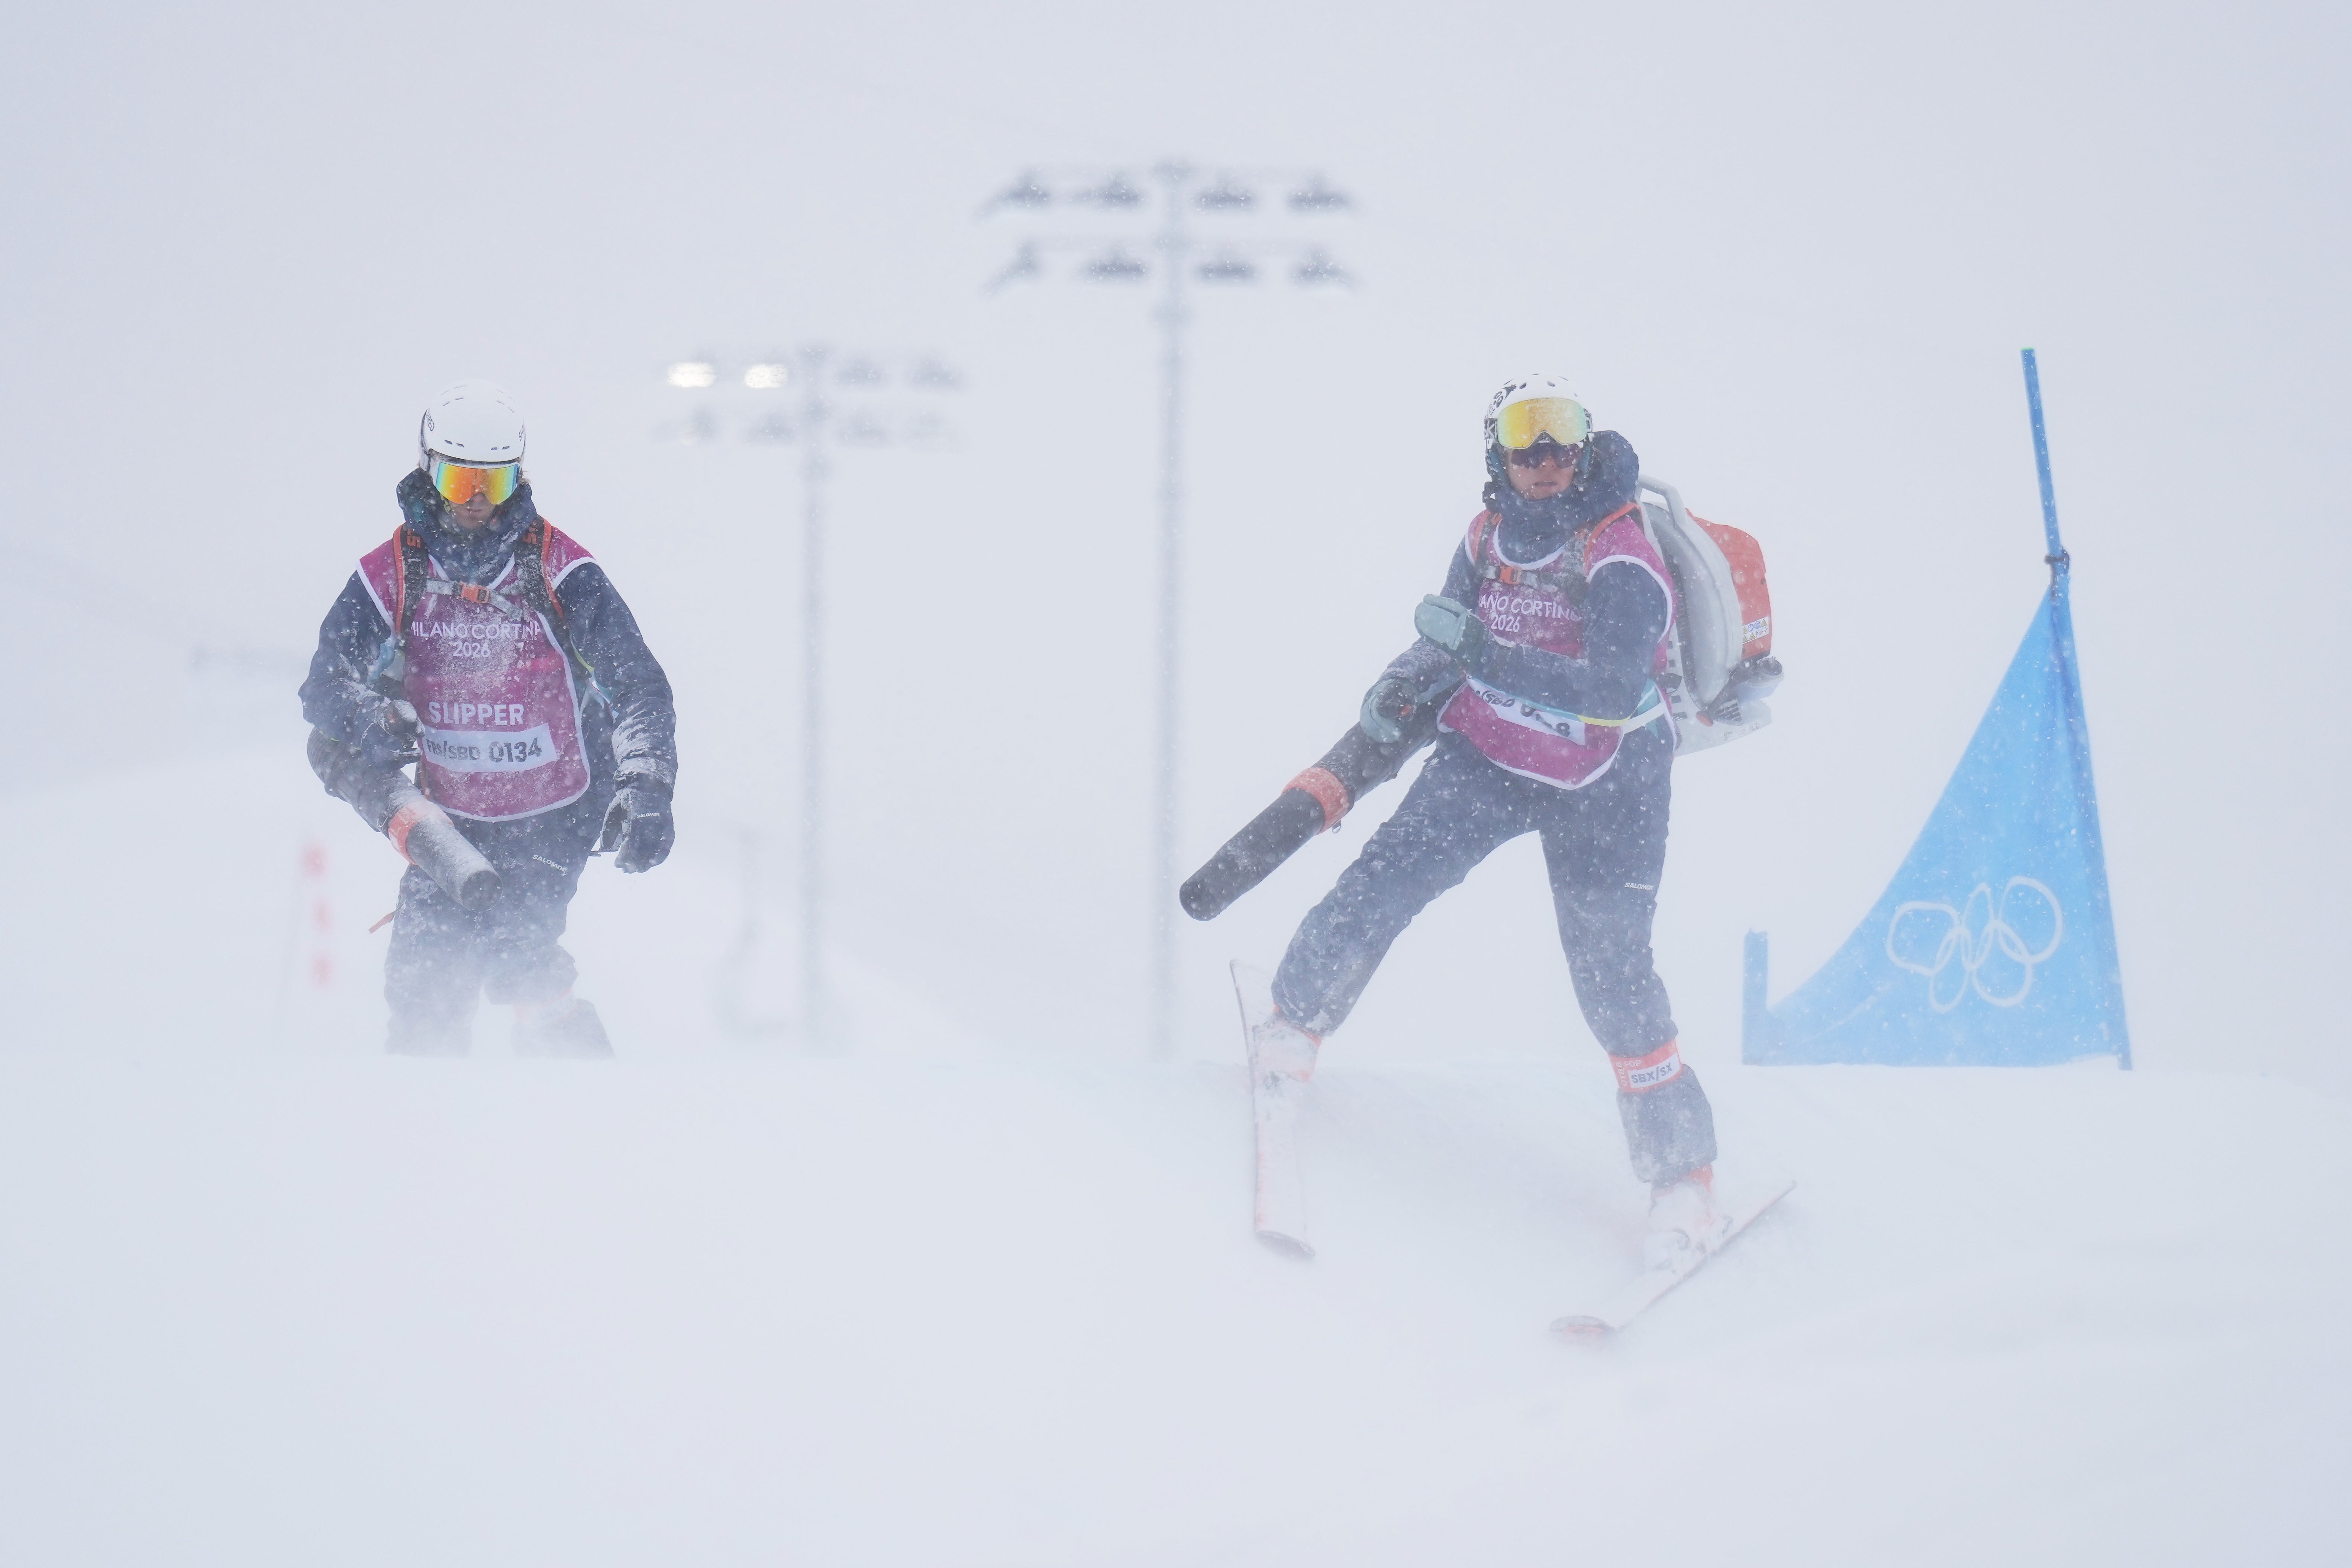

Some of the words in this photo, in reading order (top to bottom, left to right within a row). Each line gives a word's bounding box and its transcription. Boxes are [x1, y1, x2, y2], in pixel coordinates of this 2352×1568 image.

[1491, 613, 1520, 632] 2026
[452, 642, 490, 657] 2026
[428, 701, 524, 725] SLIPPER
[488, 737, 542, 762] 0134
[532, 854, 567, 874] SALOMON
[1624, 882, 1654, 890] SALOMON
[1631, 1062, 1673, 1084] SBX/SX
